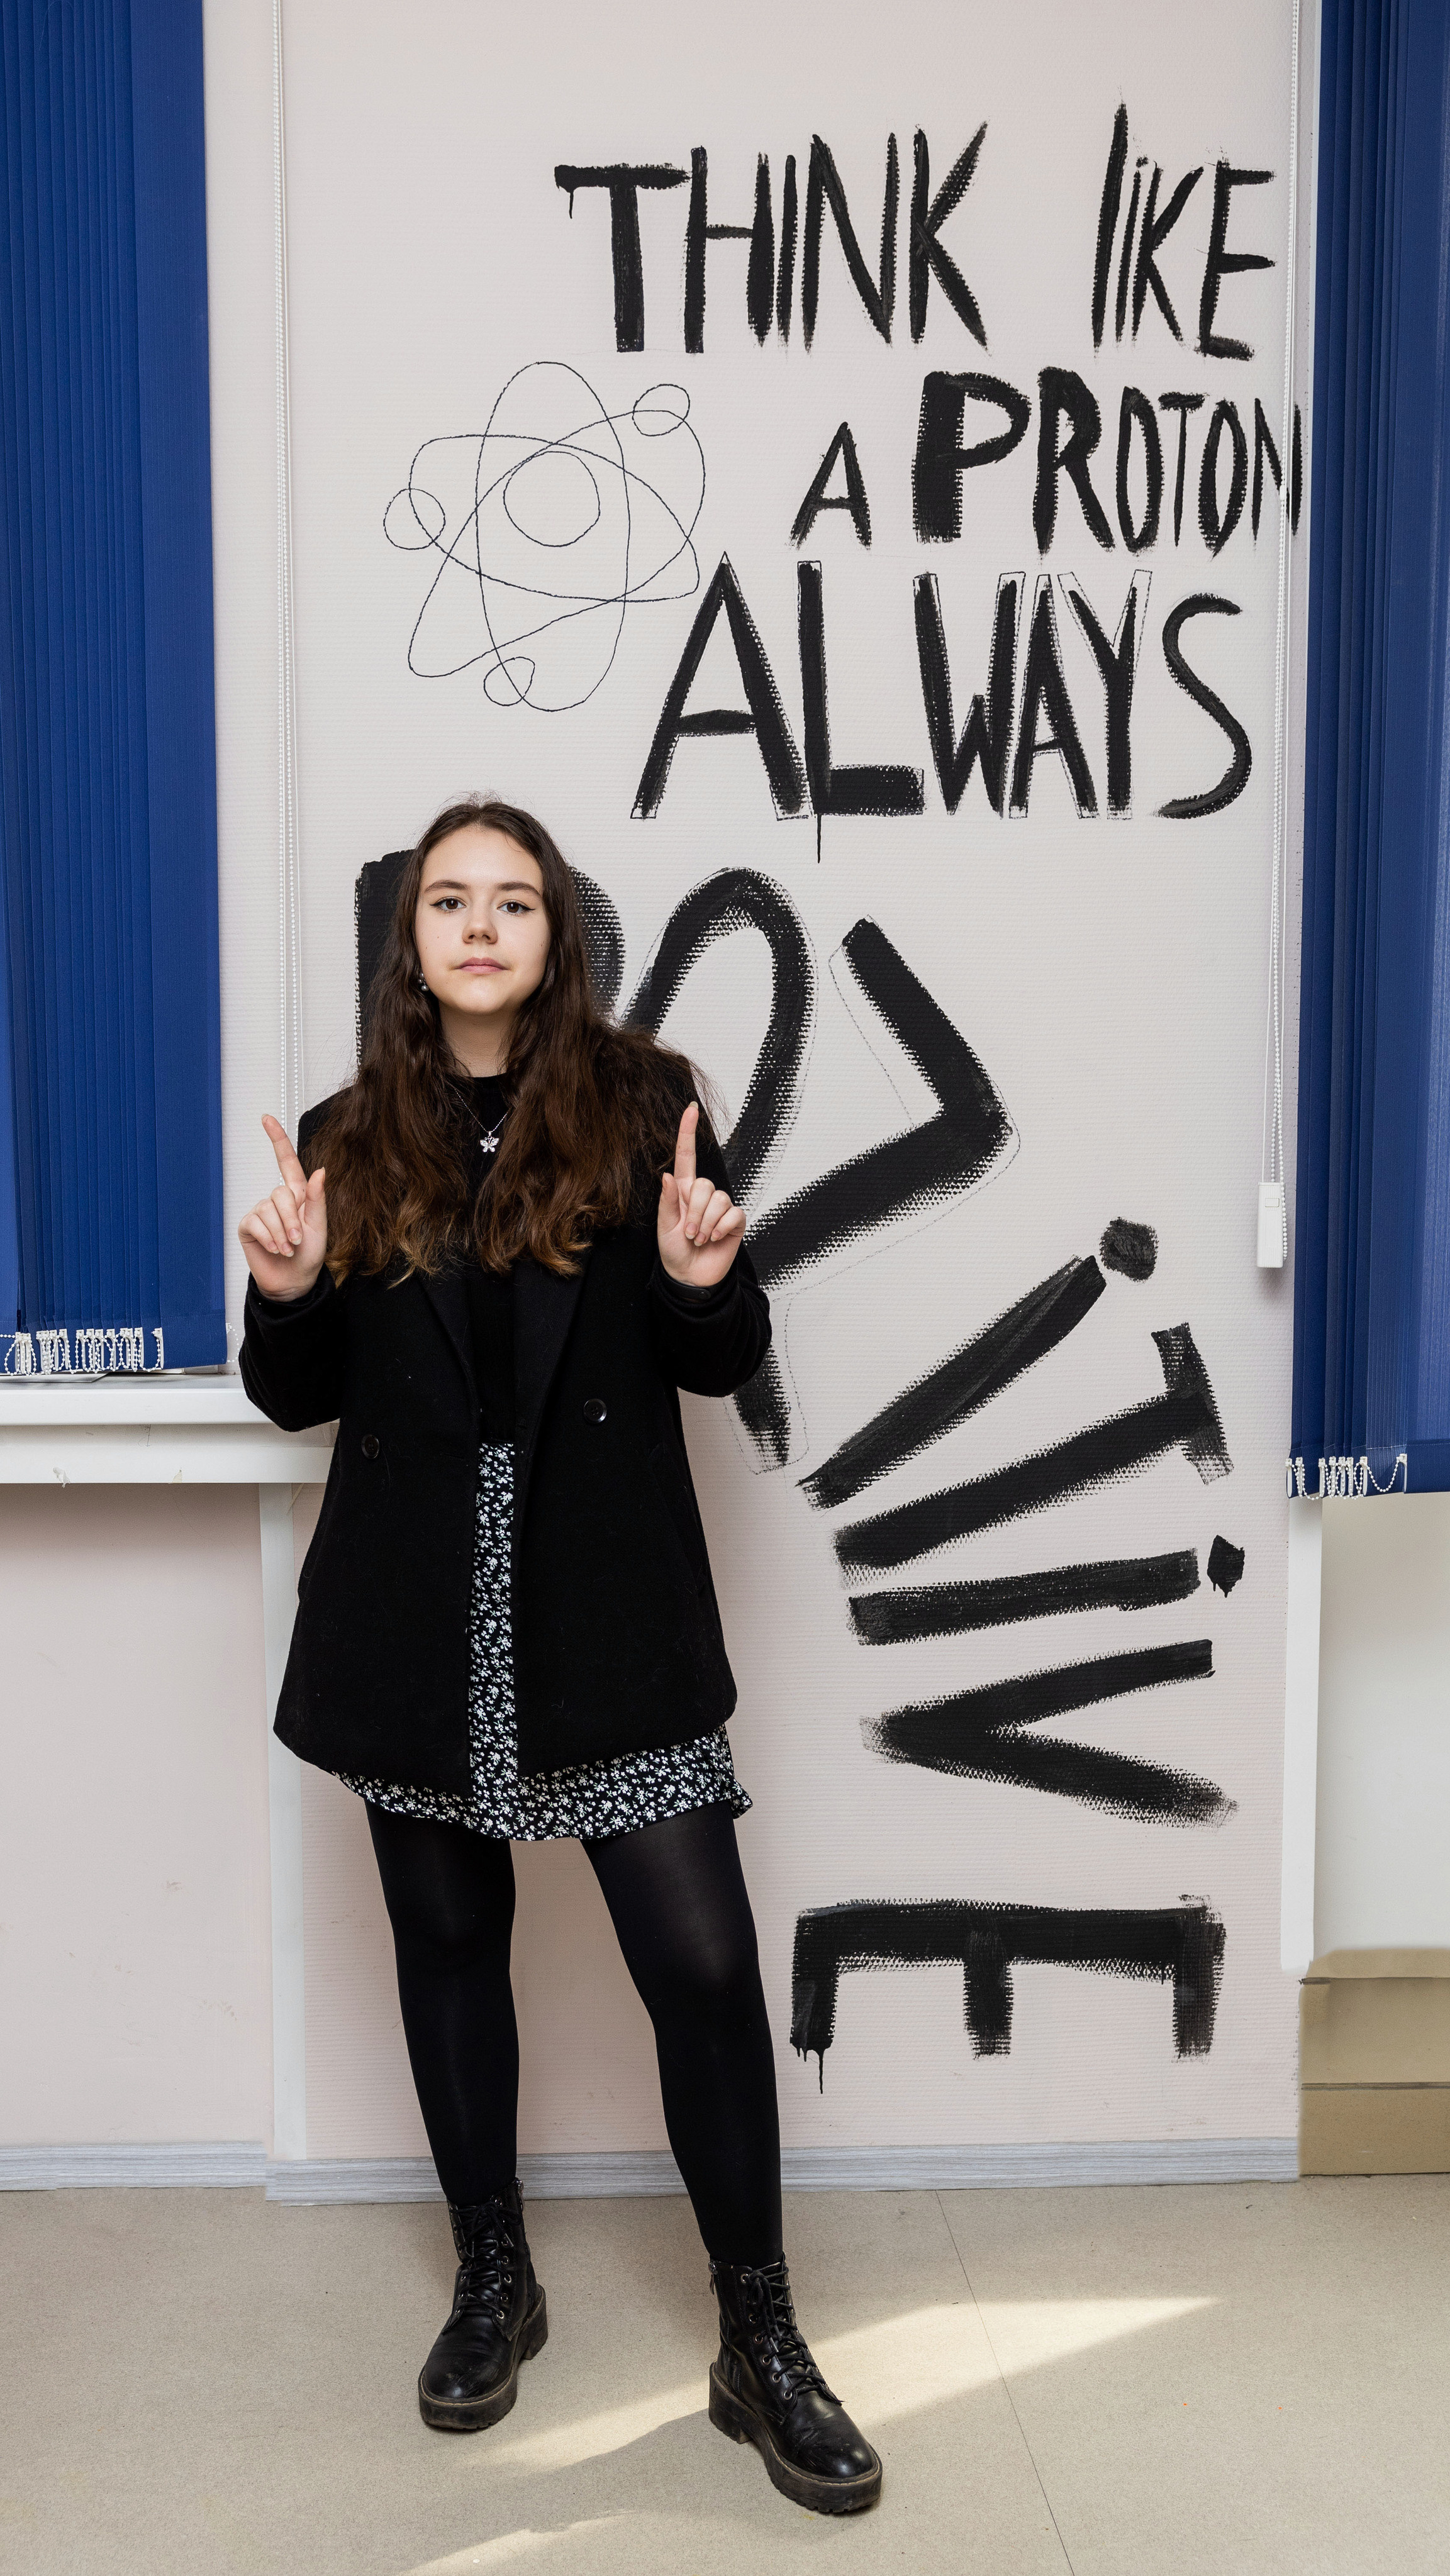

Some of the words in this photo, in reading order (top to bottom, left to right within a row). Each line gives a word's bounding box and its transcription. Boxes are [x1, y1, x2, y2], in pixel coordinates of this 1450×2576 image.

[554, 119, 991, 354] THINK
[789, 421, 872, 549] A
[911, 366, 1303, 556] PROTON
[630, 552, 1252, 821] ALWAYS
